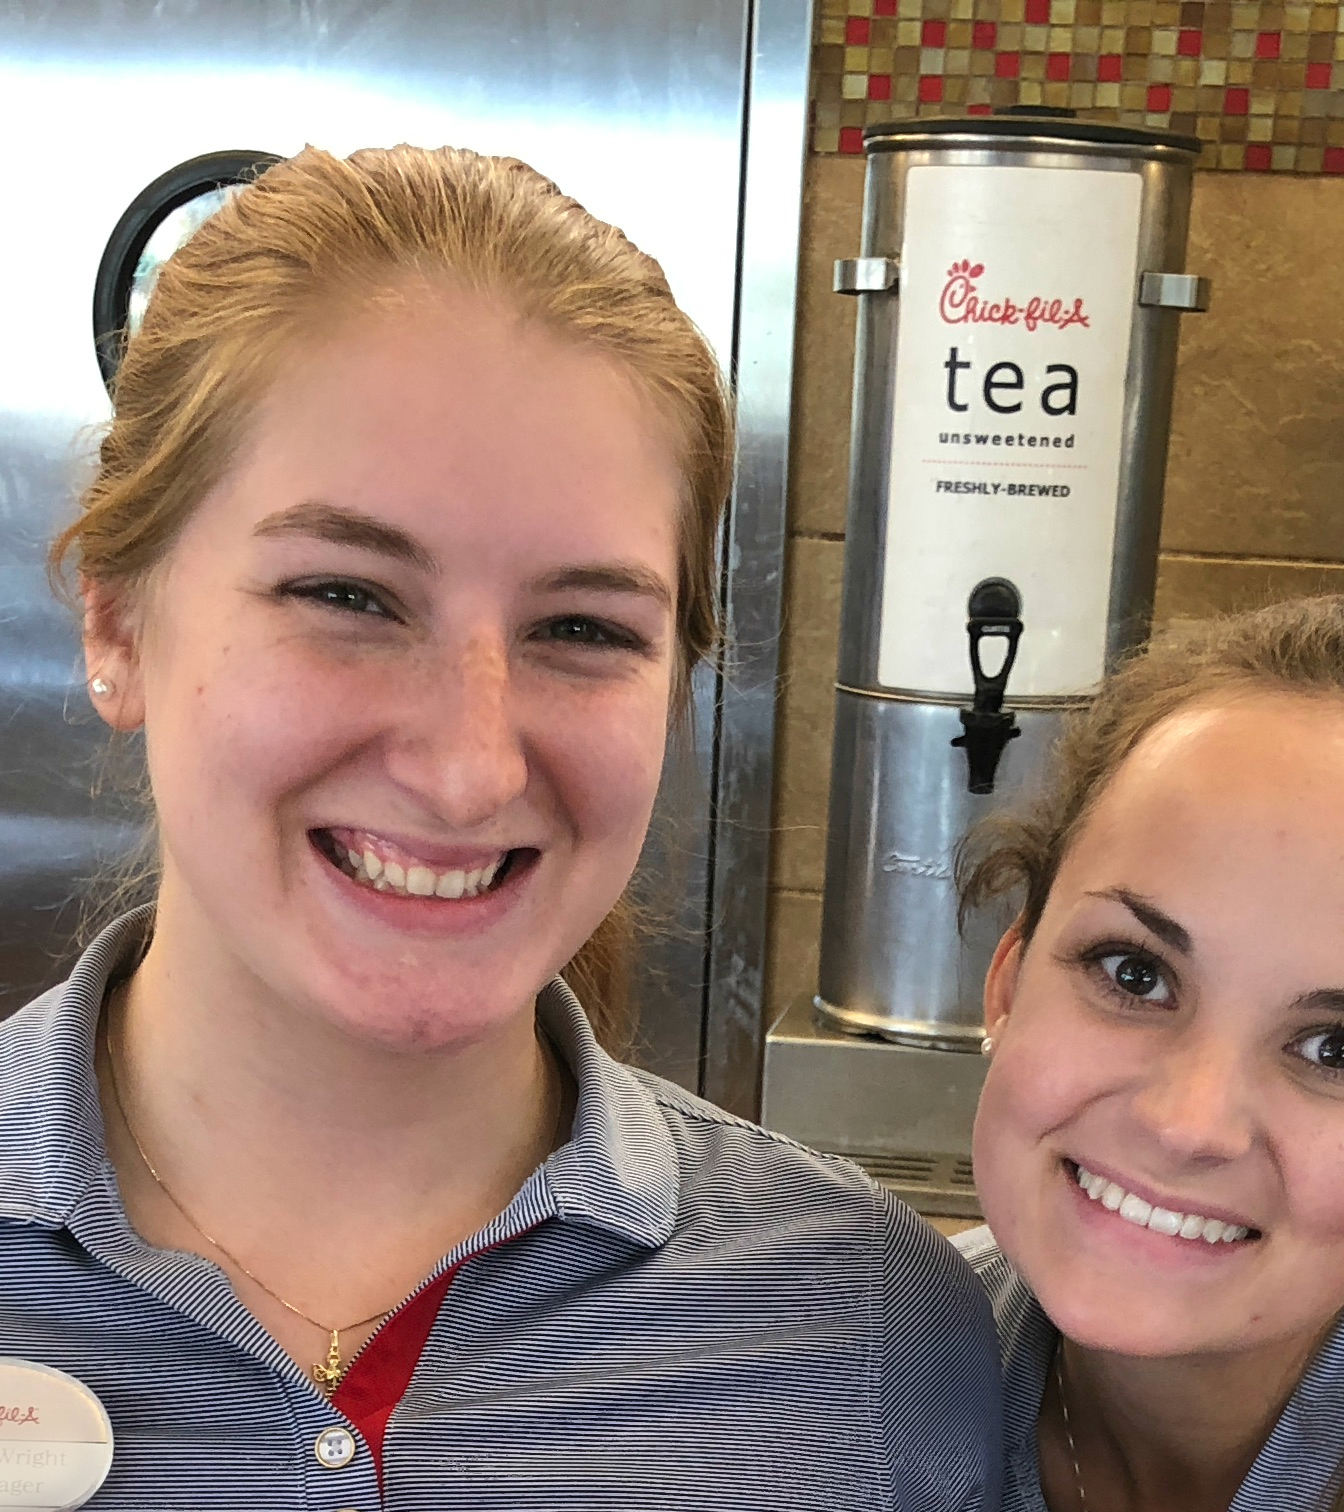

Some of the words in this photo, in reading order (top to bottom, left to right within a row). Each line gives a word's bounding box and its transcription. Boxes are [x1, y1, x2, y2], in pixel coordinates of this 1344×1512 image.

[943, 347, 1079, 416] tea
[938, 431, 1076, 448] unsweetened
[935, 480, 1071, 498] FRESHLY-BREWED
